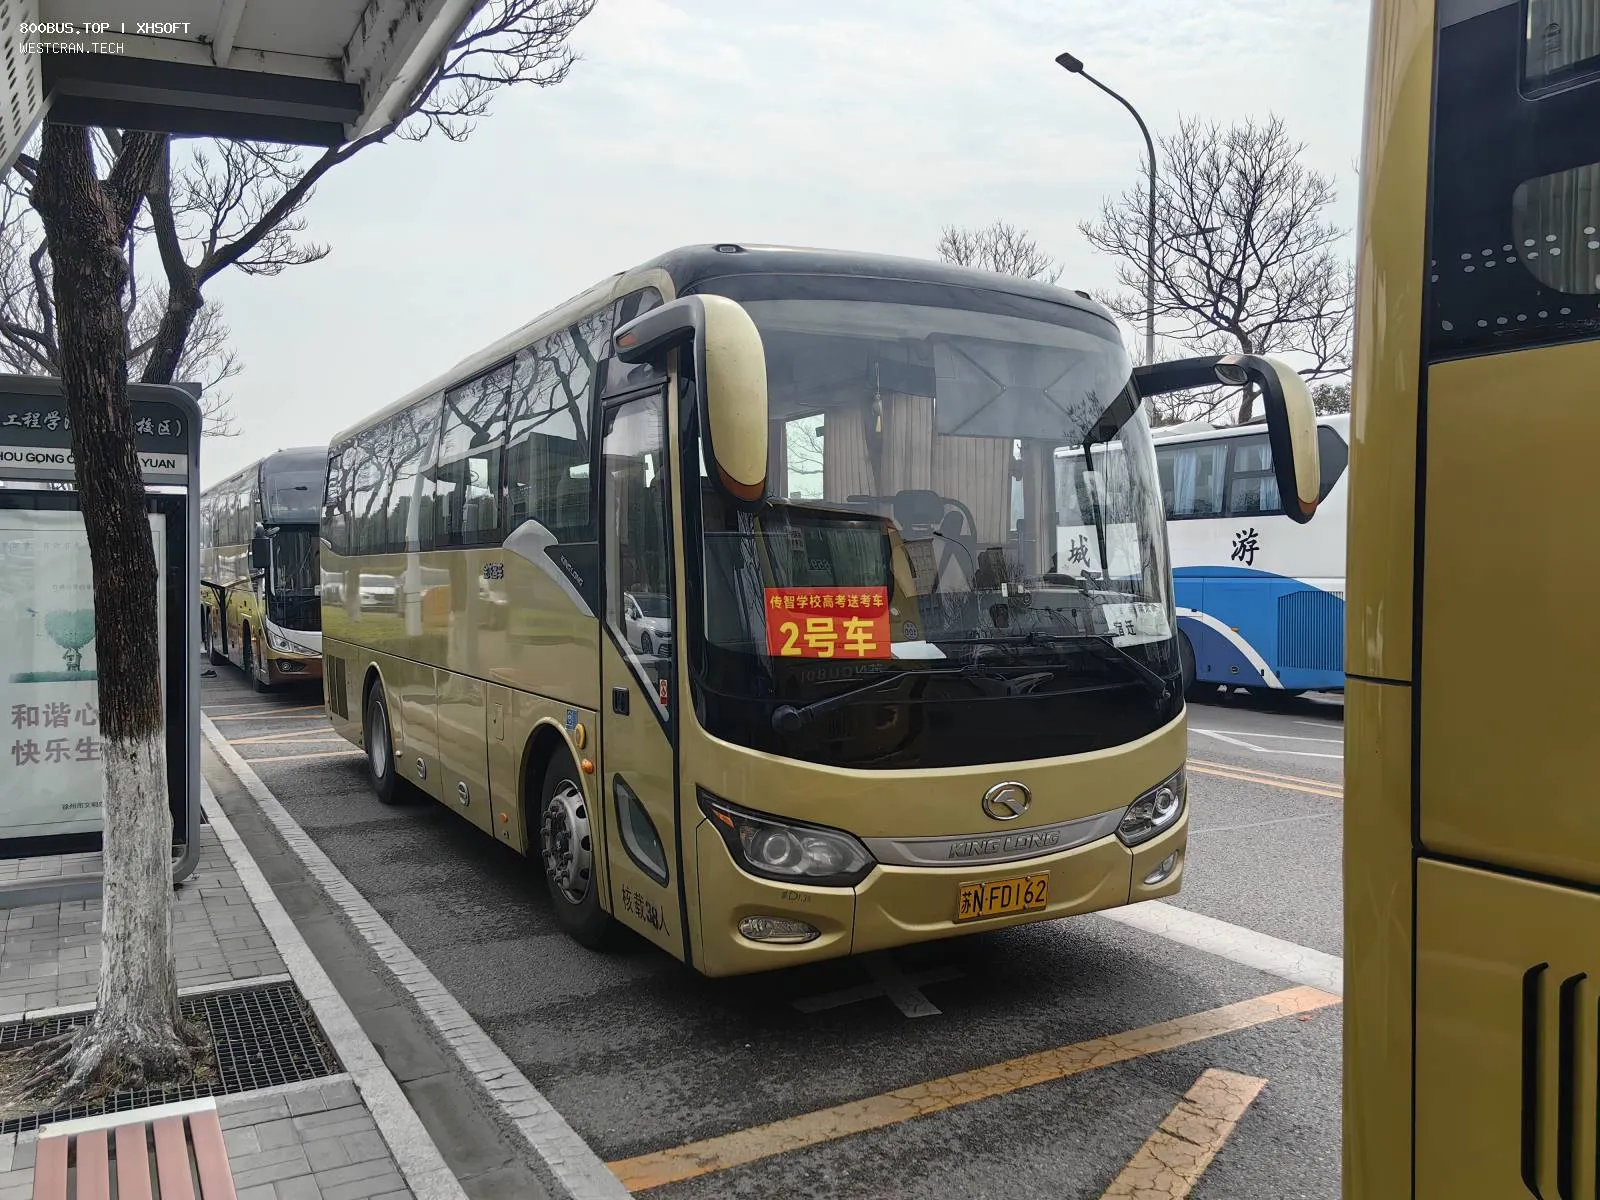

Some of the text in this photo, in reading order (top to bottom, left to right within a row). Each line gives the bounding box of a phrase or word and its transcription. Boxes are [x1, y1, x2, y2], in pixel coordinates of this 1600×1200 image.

[26, 452, 64, 464] GONG
[141, 458, 176, 469] YUAN
[1068, 527, 1260, 568] 城 游
[770, 593, 884, 609] 传智学校高考送考车
[779, 616, 877, 658] 2号车
[12, 701, 99, 730] 和谐心
[12, 736, 101, 766] 快乐生
[949, 830, 1060, 859] KING LONG
